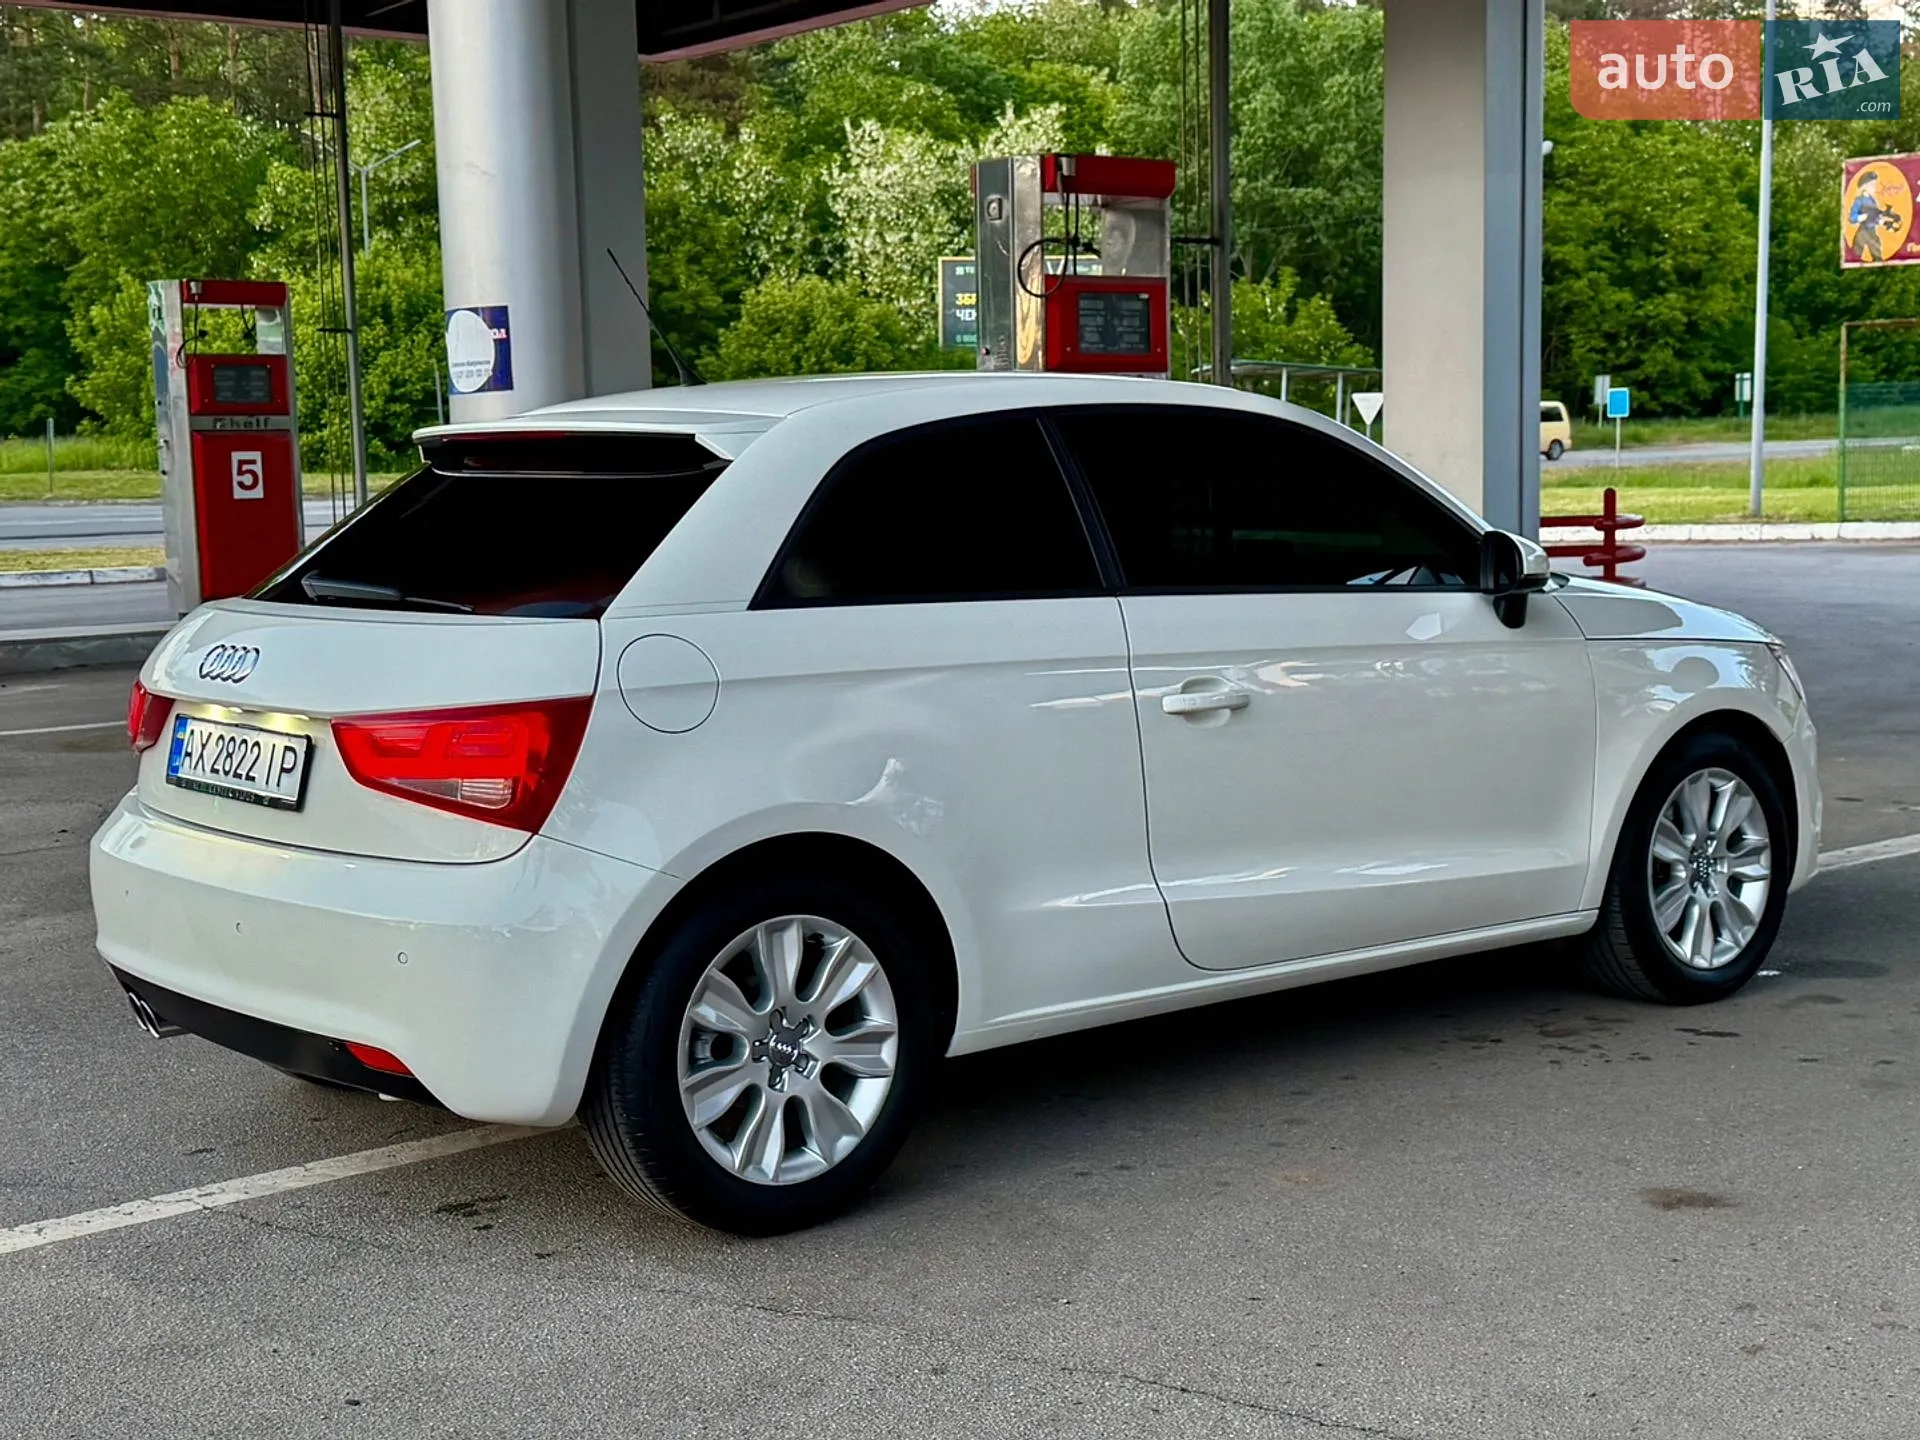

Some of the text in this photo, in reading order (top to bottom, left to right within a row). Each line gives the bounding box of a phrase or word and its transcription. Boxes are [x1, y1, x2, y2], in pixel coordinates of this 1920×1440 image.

[236, 459, 259, 491] 5
[210, 733, 261, 782] 2822
[265, 743, 298, 788] IP
